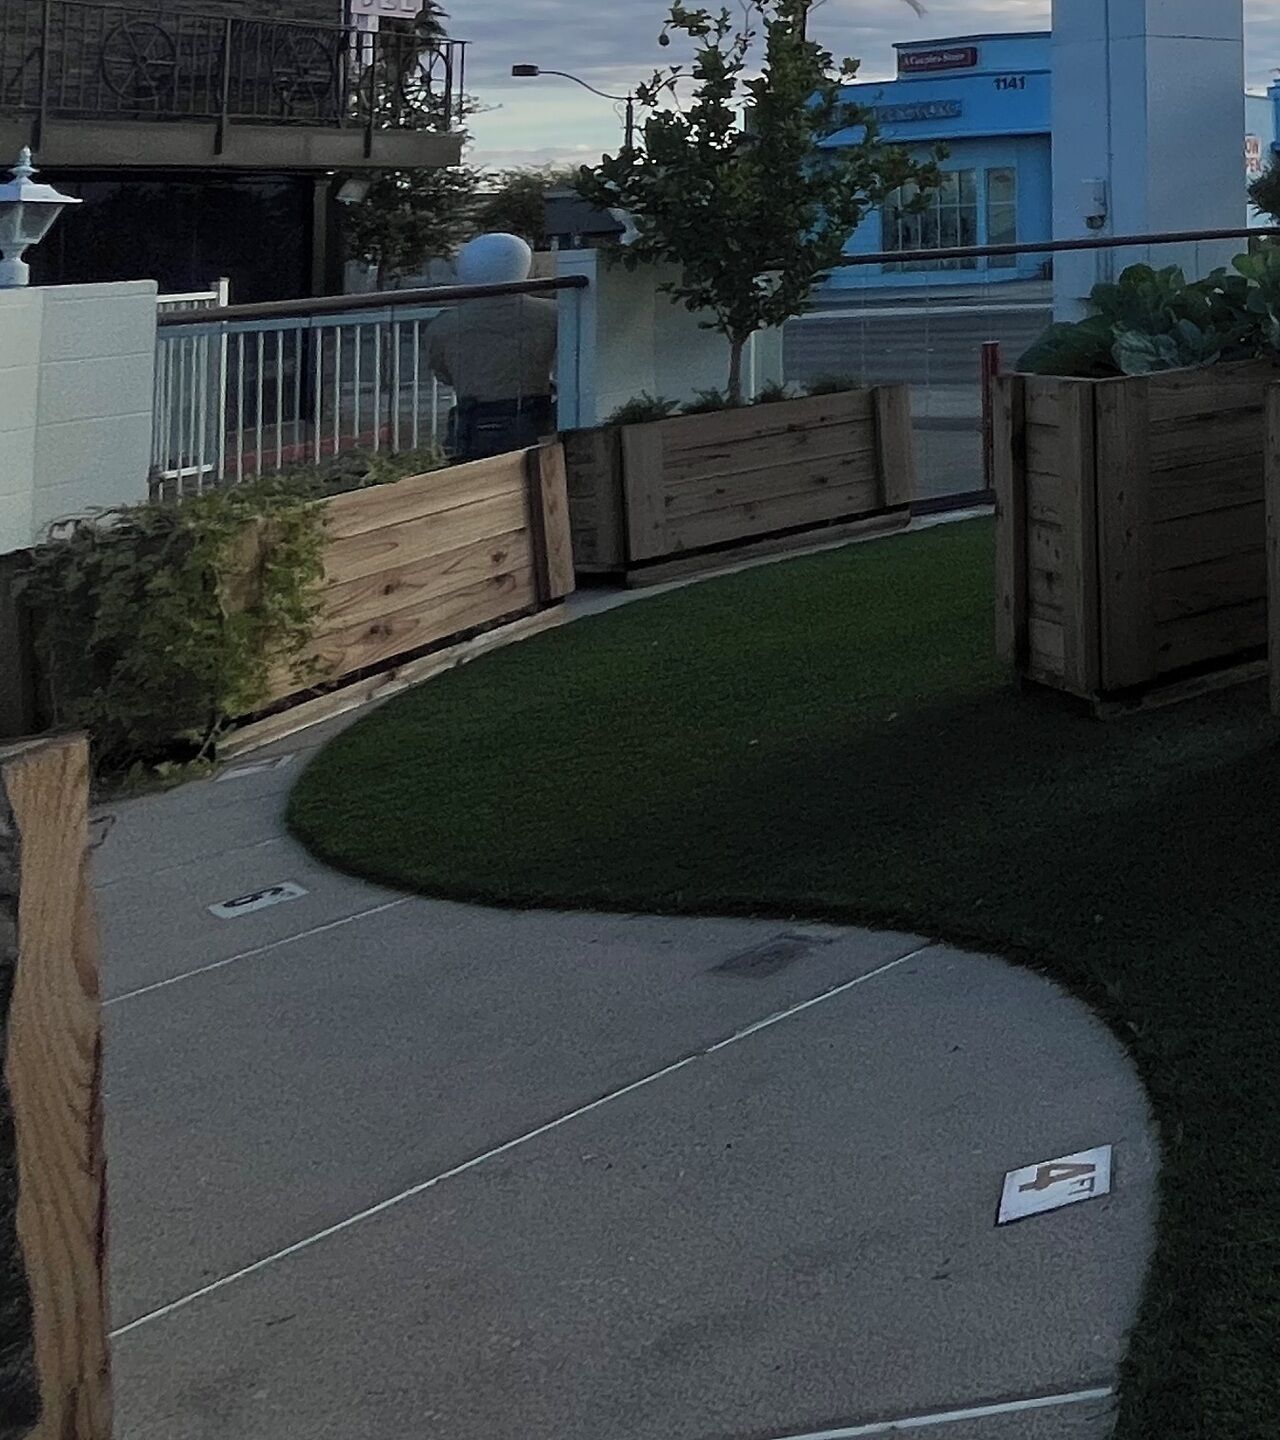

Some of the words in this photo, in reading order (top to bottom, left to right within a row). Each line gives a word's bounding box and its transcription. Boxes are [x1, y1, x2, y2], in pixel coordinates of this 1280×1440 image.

[993, 76, 1026, 90] 1141
[1245, 138, 1259, 154] OW
[1245, 157, 1261, 173] PEN
